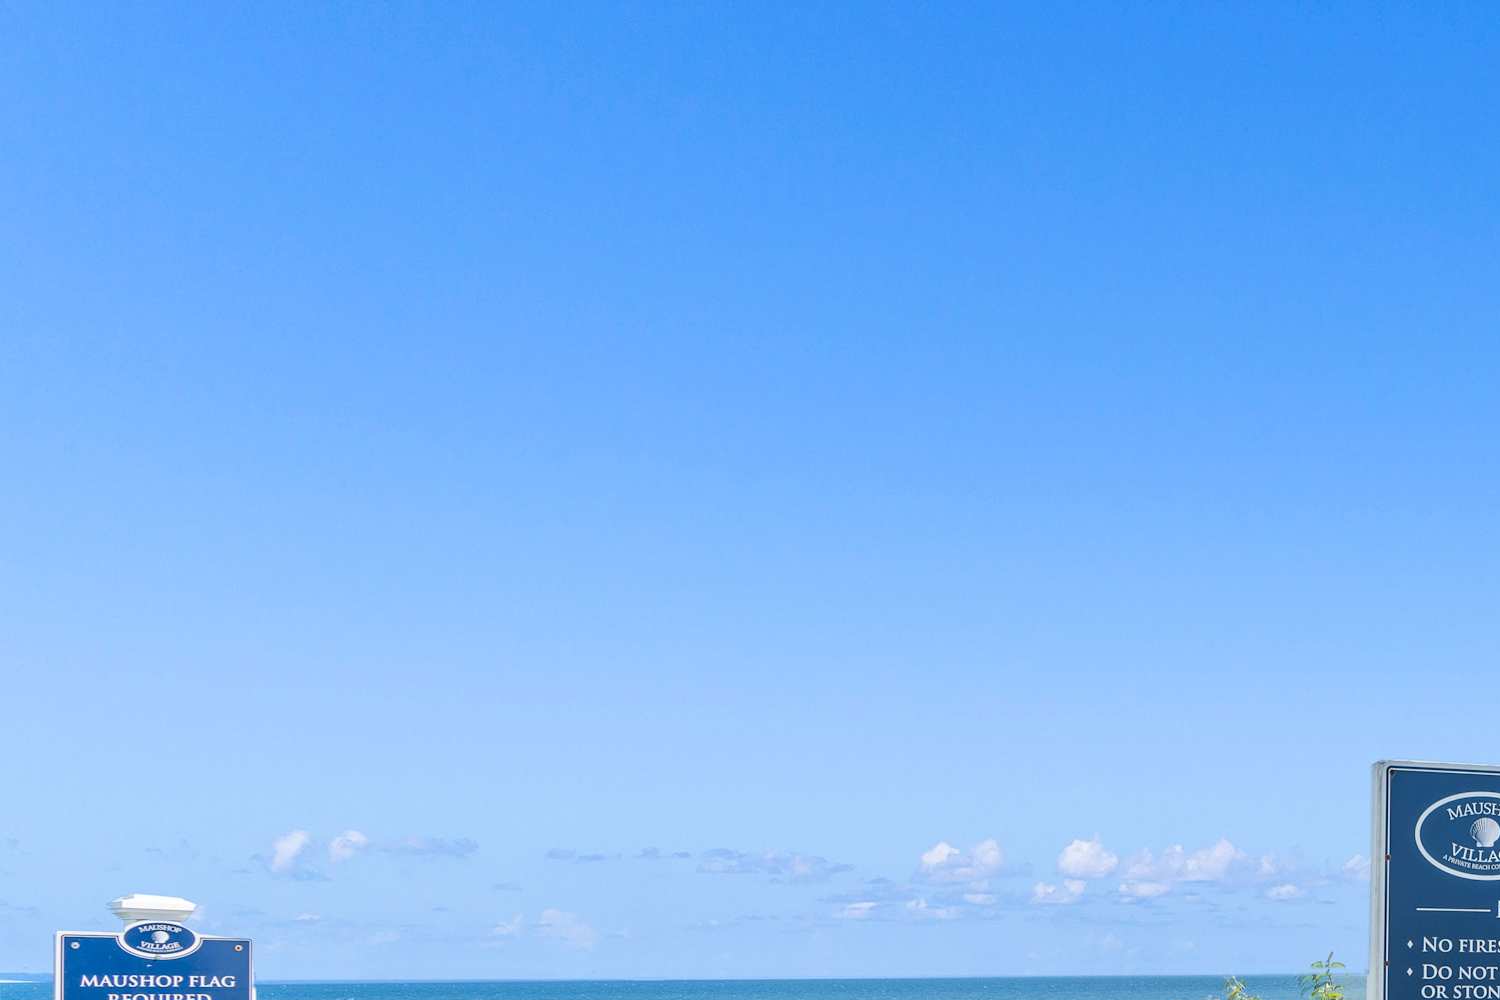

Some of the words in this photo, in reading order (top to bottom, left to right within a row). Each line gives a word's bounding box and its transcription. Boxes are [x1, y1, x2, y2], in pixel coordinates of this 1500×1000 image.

[138, 925, 182, 934] MAUSHOP
[141, 941, 181, 951] VILLAGE
[1422, 936, 1453, 953] NO
[1422, 963, 1453, 980] DO
[1457, 965, 1499, 981] NOT
[79, 974, 184, 988] MAUSHOP
[189, 975, 236, 988] FLAG
[1420, 984, 1449, 999] OR
